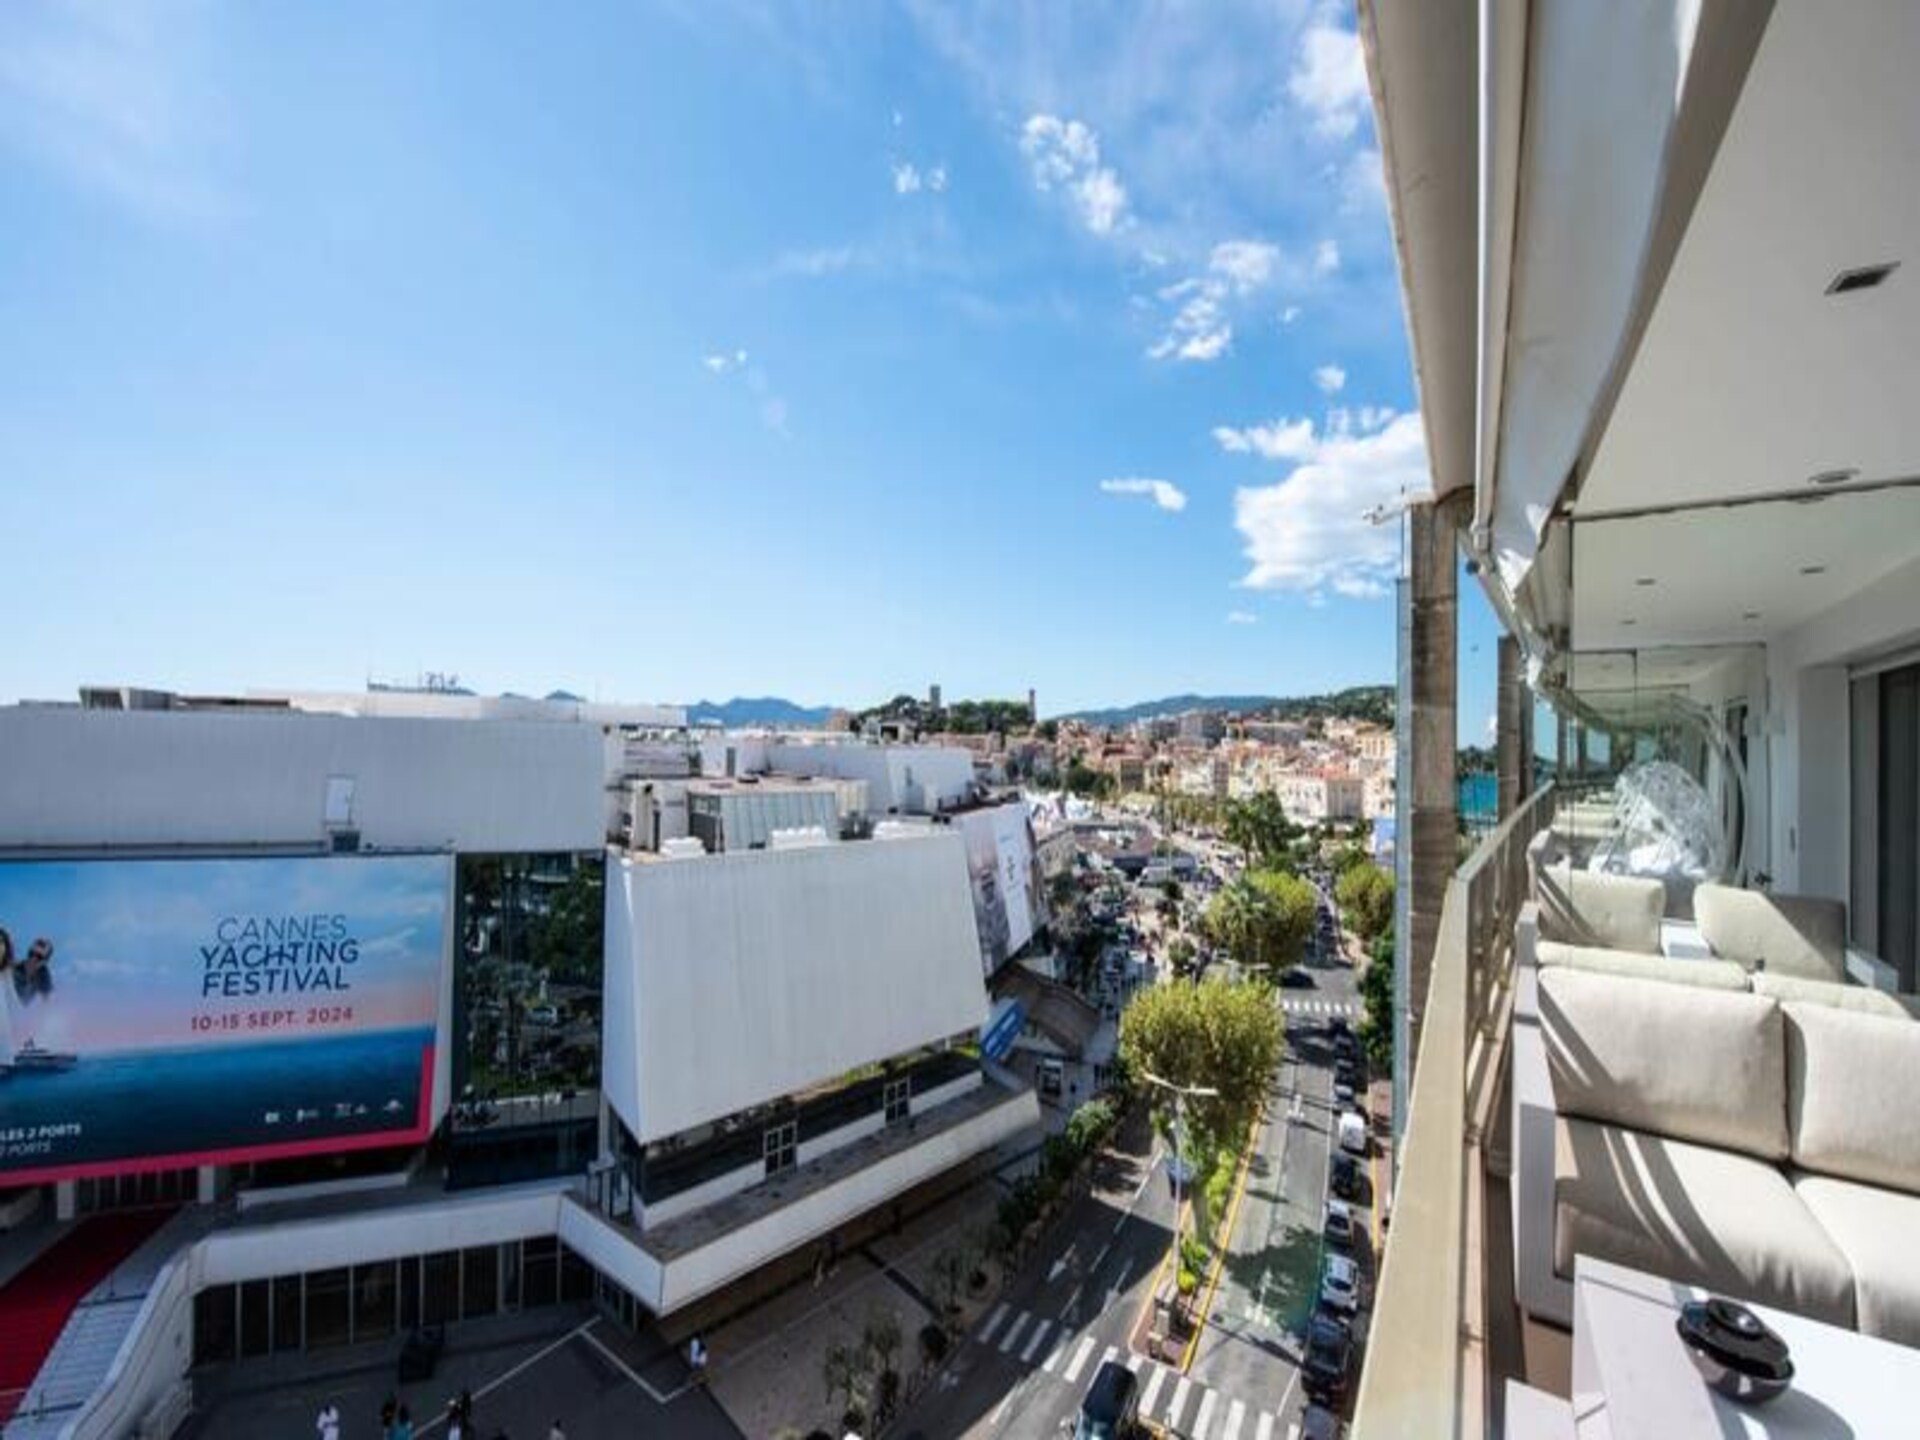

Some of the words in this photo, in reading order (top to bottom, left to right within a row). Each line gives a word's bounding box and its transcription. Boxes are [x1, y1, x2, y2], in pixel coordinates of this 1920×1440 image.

[217, 914, 347, 944] CANNES
[200, 938, 360, 970] YACHTING
[202, 966, 351, 998] FESTIVAL
[191, 1013, 240, 1031] 10-15
[246, 1010, 299, 1028] SEPT.
[306, 1007, 354, 1025] 2024
[39, 1122, 82, 1138] PORTS
